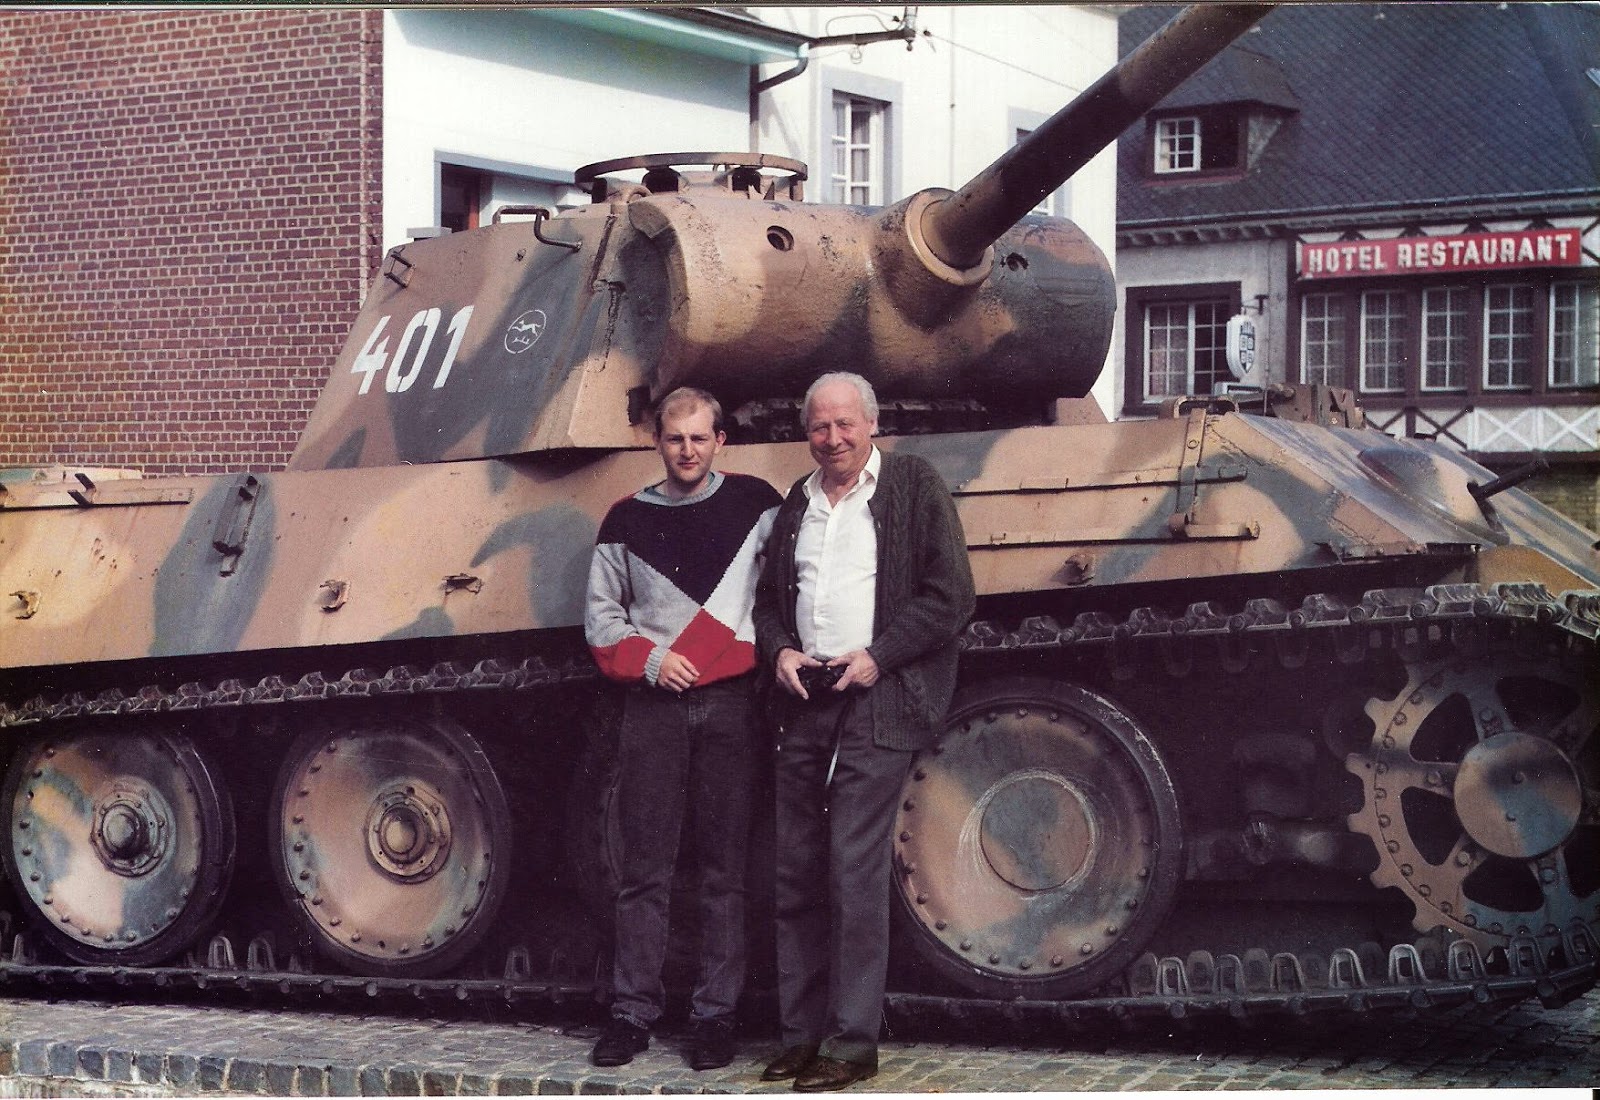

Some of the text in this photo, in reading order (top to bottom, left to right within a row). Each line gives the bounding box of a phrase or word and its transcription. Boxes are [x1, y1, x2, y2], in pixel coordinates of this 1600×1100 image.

[1308, 233, 1573, 273] HOTEL RESTAURANT
[350, 304, 475, 395] 401
